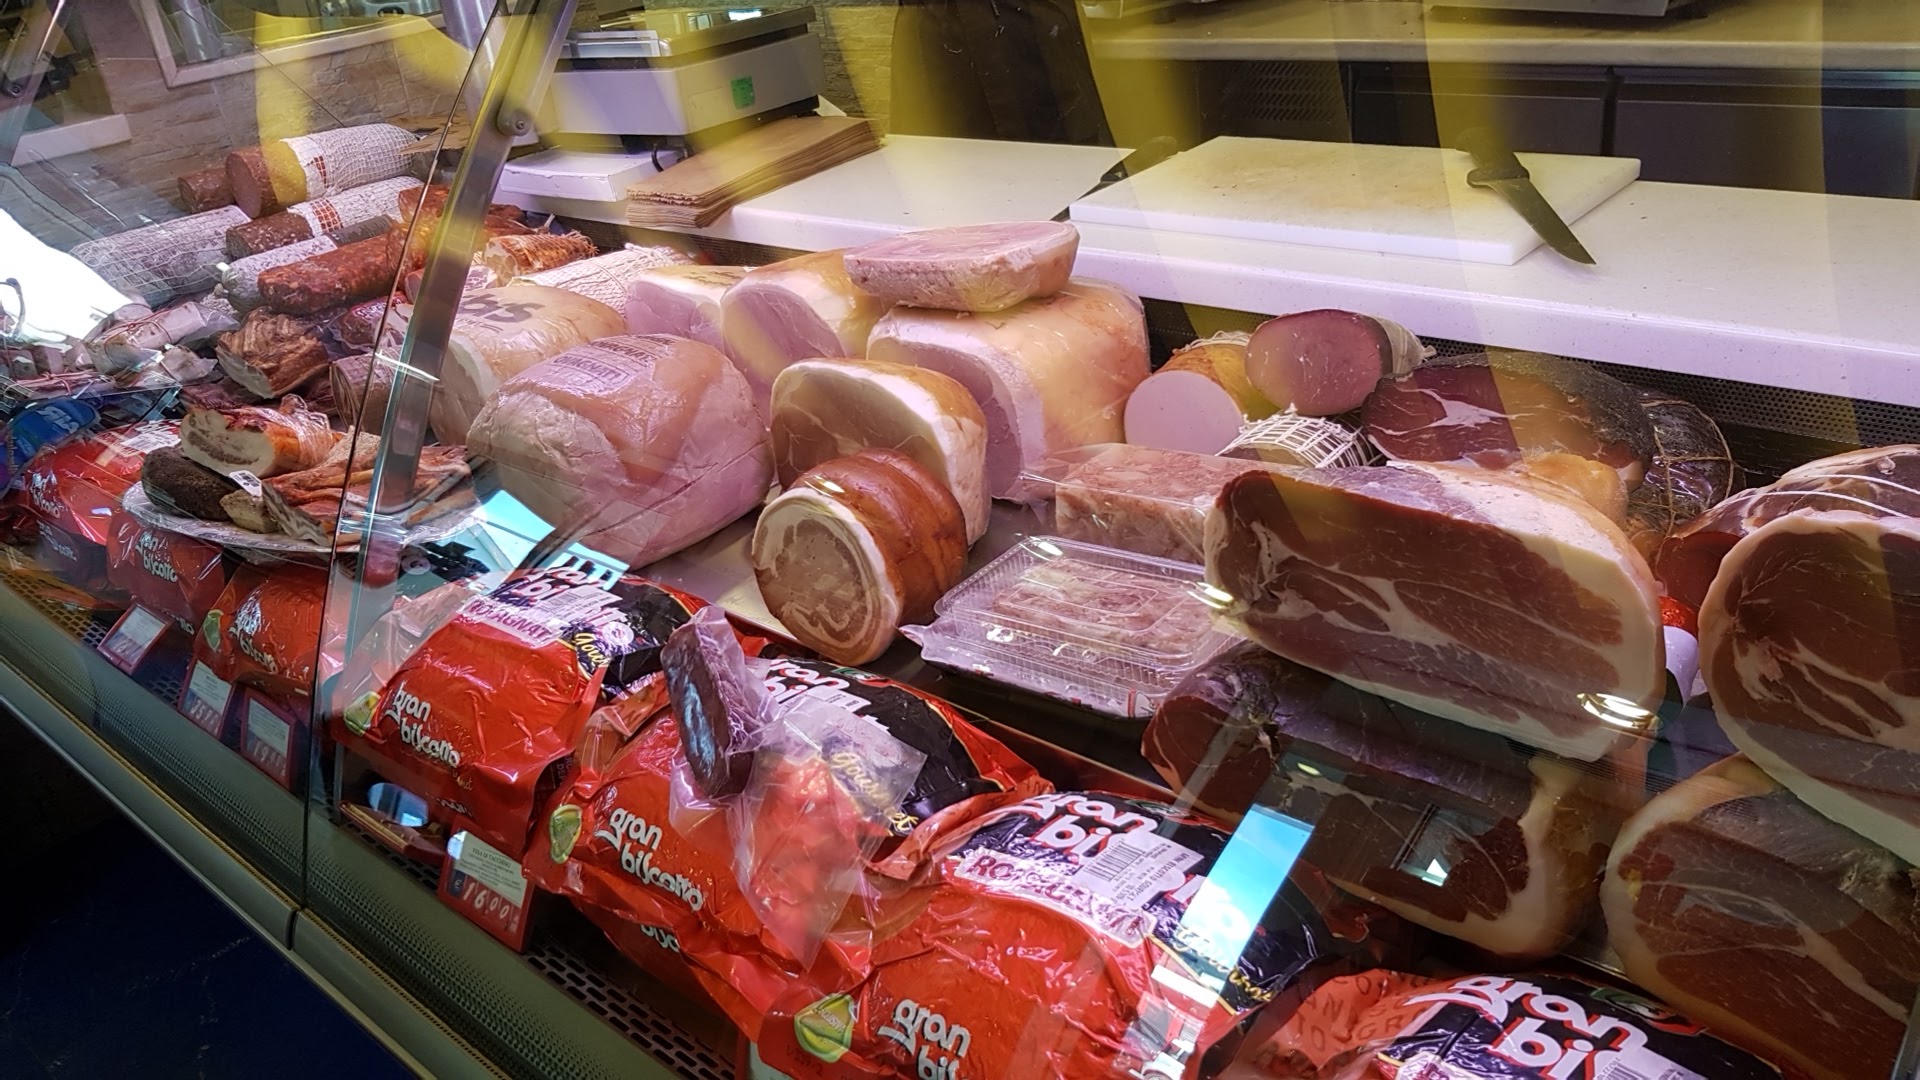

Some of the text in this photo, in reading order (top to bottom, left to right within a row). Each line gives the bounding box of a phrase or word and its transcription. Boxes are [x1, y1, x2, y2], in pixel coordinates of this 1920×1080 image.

[594, 807, 663, 851] gran
[620, 841, 705, 912] biscotto
[877, 999, 972, 1059] gran
[1402, 976, 1649, 1050] gran
